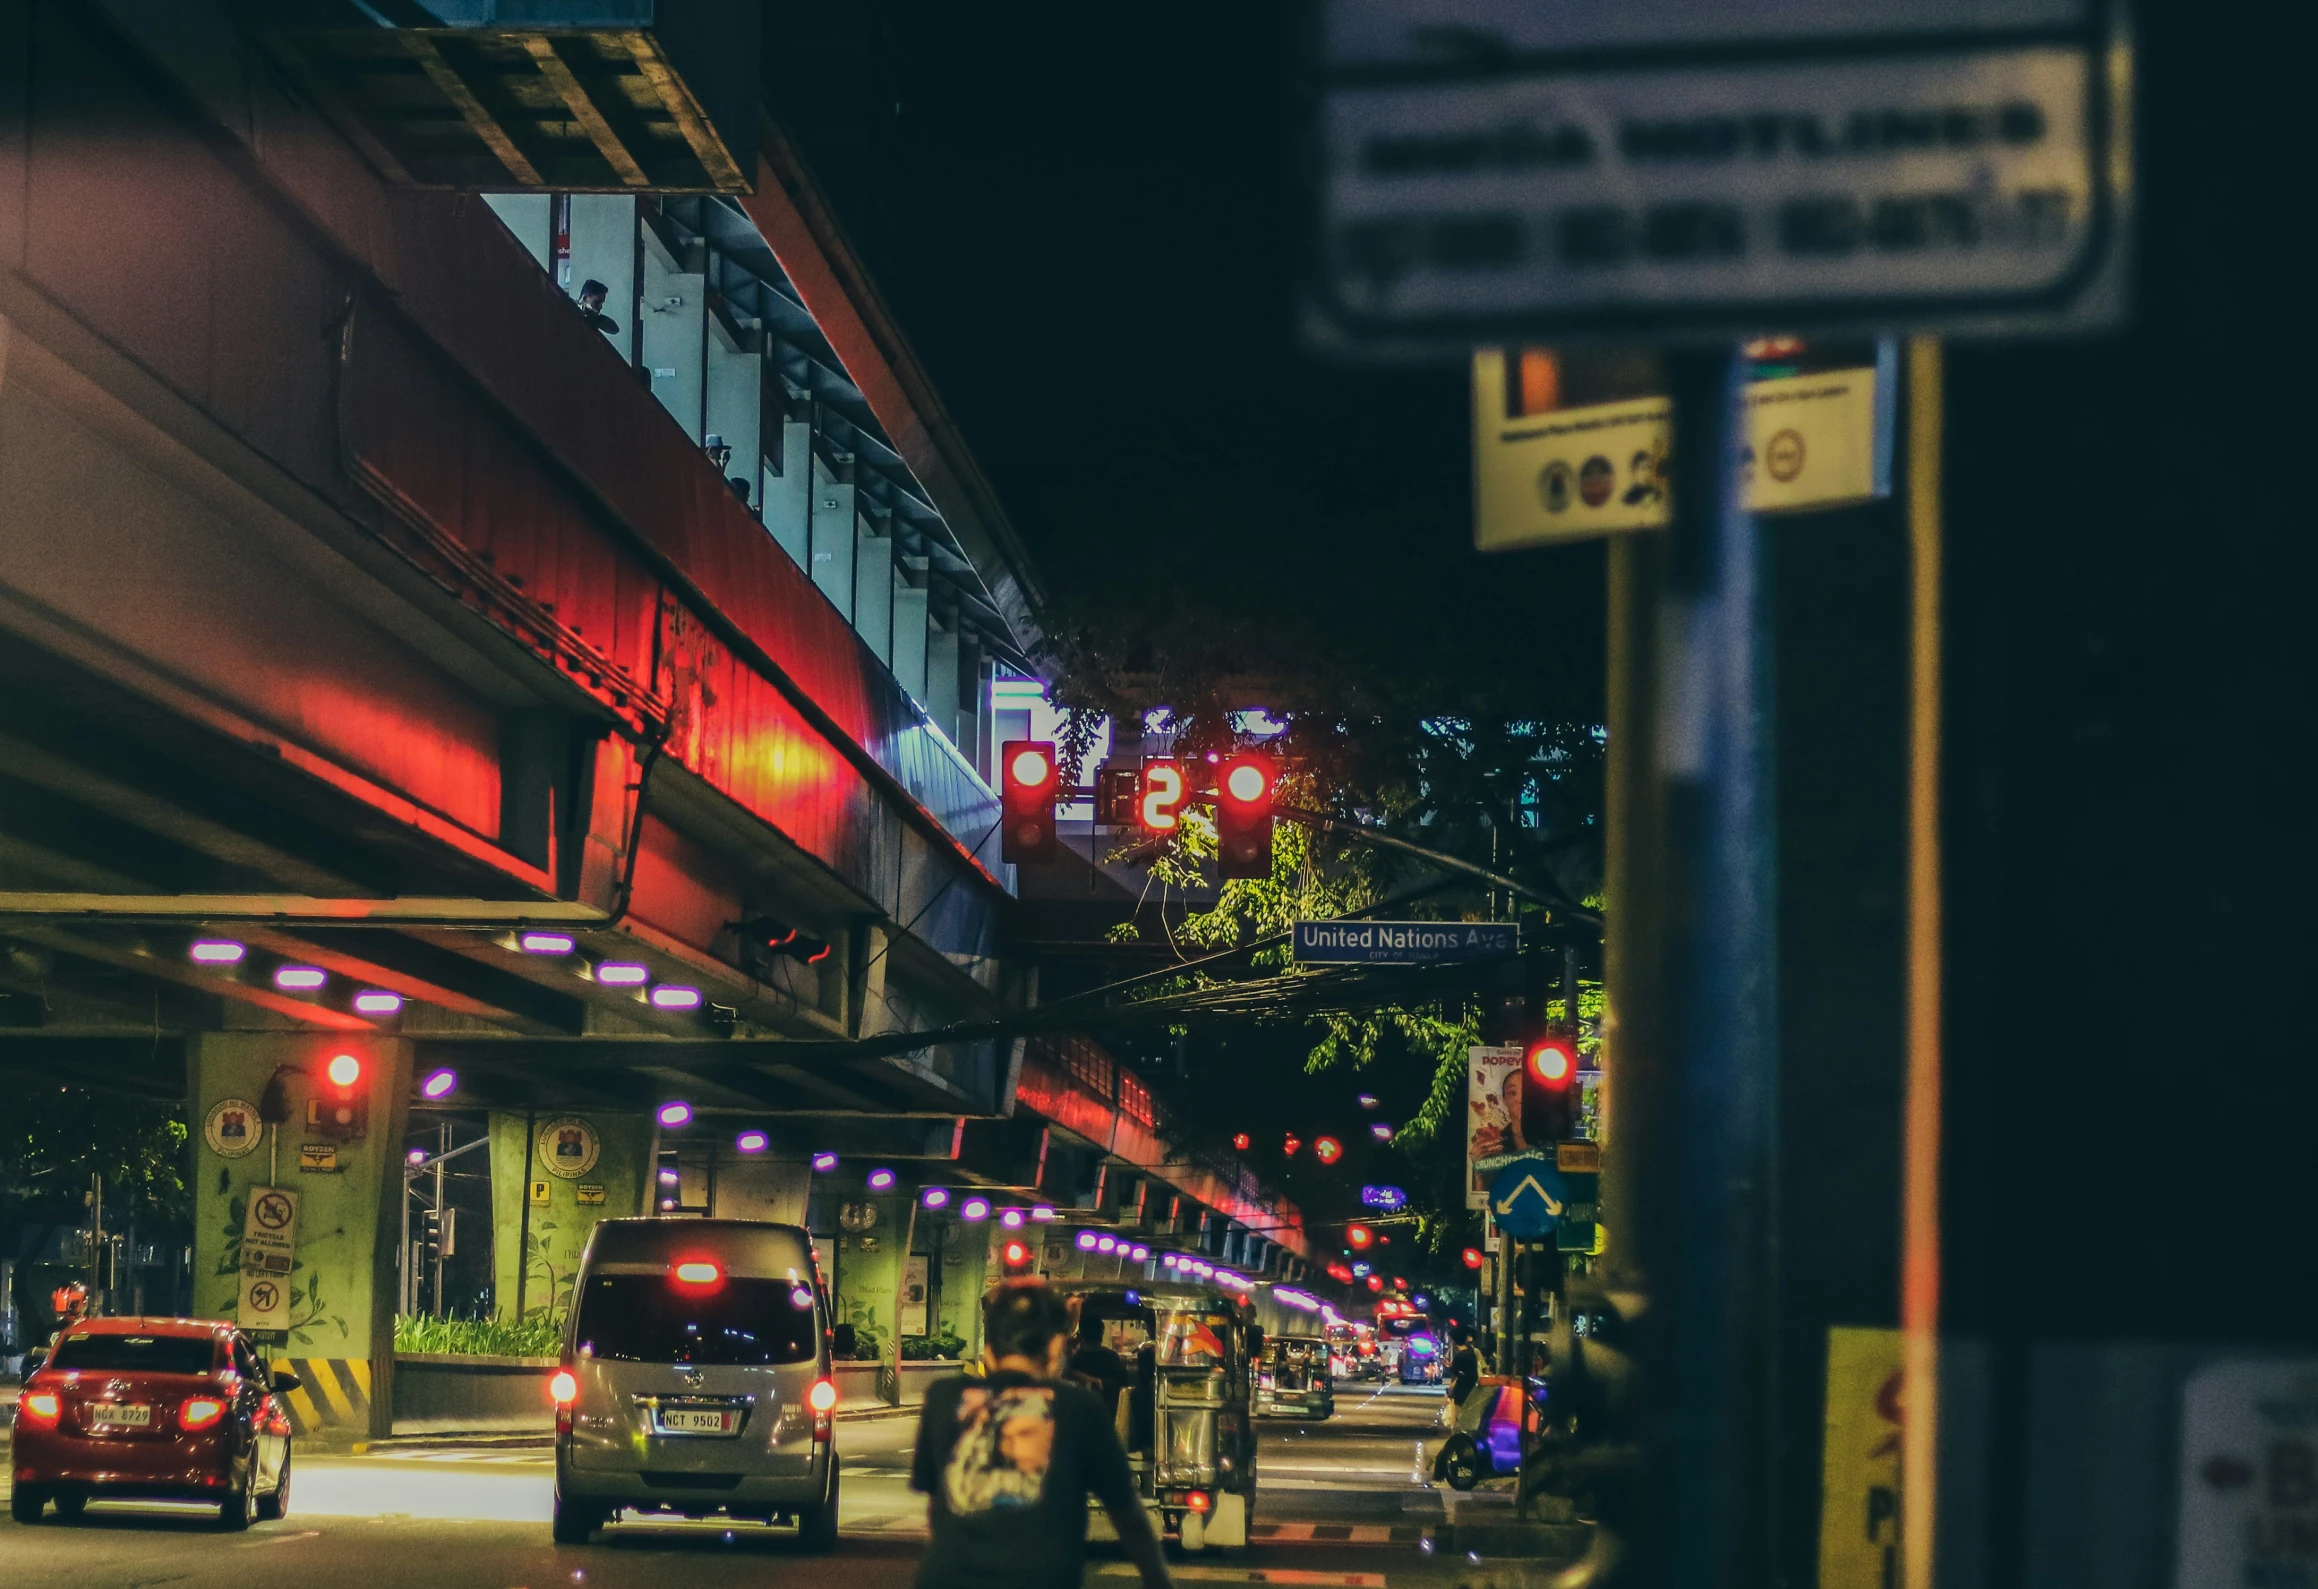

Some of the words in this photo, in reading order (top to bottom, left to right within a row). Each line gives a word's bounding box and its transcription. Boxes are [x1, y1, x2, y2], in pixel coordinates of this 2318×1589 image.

[1143, 767, 1181, 829] 2
[1303, 926, 1372, 948] United
[1378, 927, 1458, 949] Nations
[1466, 929, 1507, 949] Ave
[1369, 951, 1389, 959] CITY
[303, 1145, 335, 1153] BOYSEN
[552, 1167, 587, 1178] PILIPINAS
[254, 1231, 284, 1240] TRICYCLE
[260, 1240, 290, 1249] ALLOWED
[122, 1410, 148, 1421] 8729
[665, 1413, 686, 1427] NCT
[693, 1414, 720, 1428] 9502
